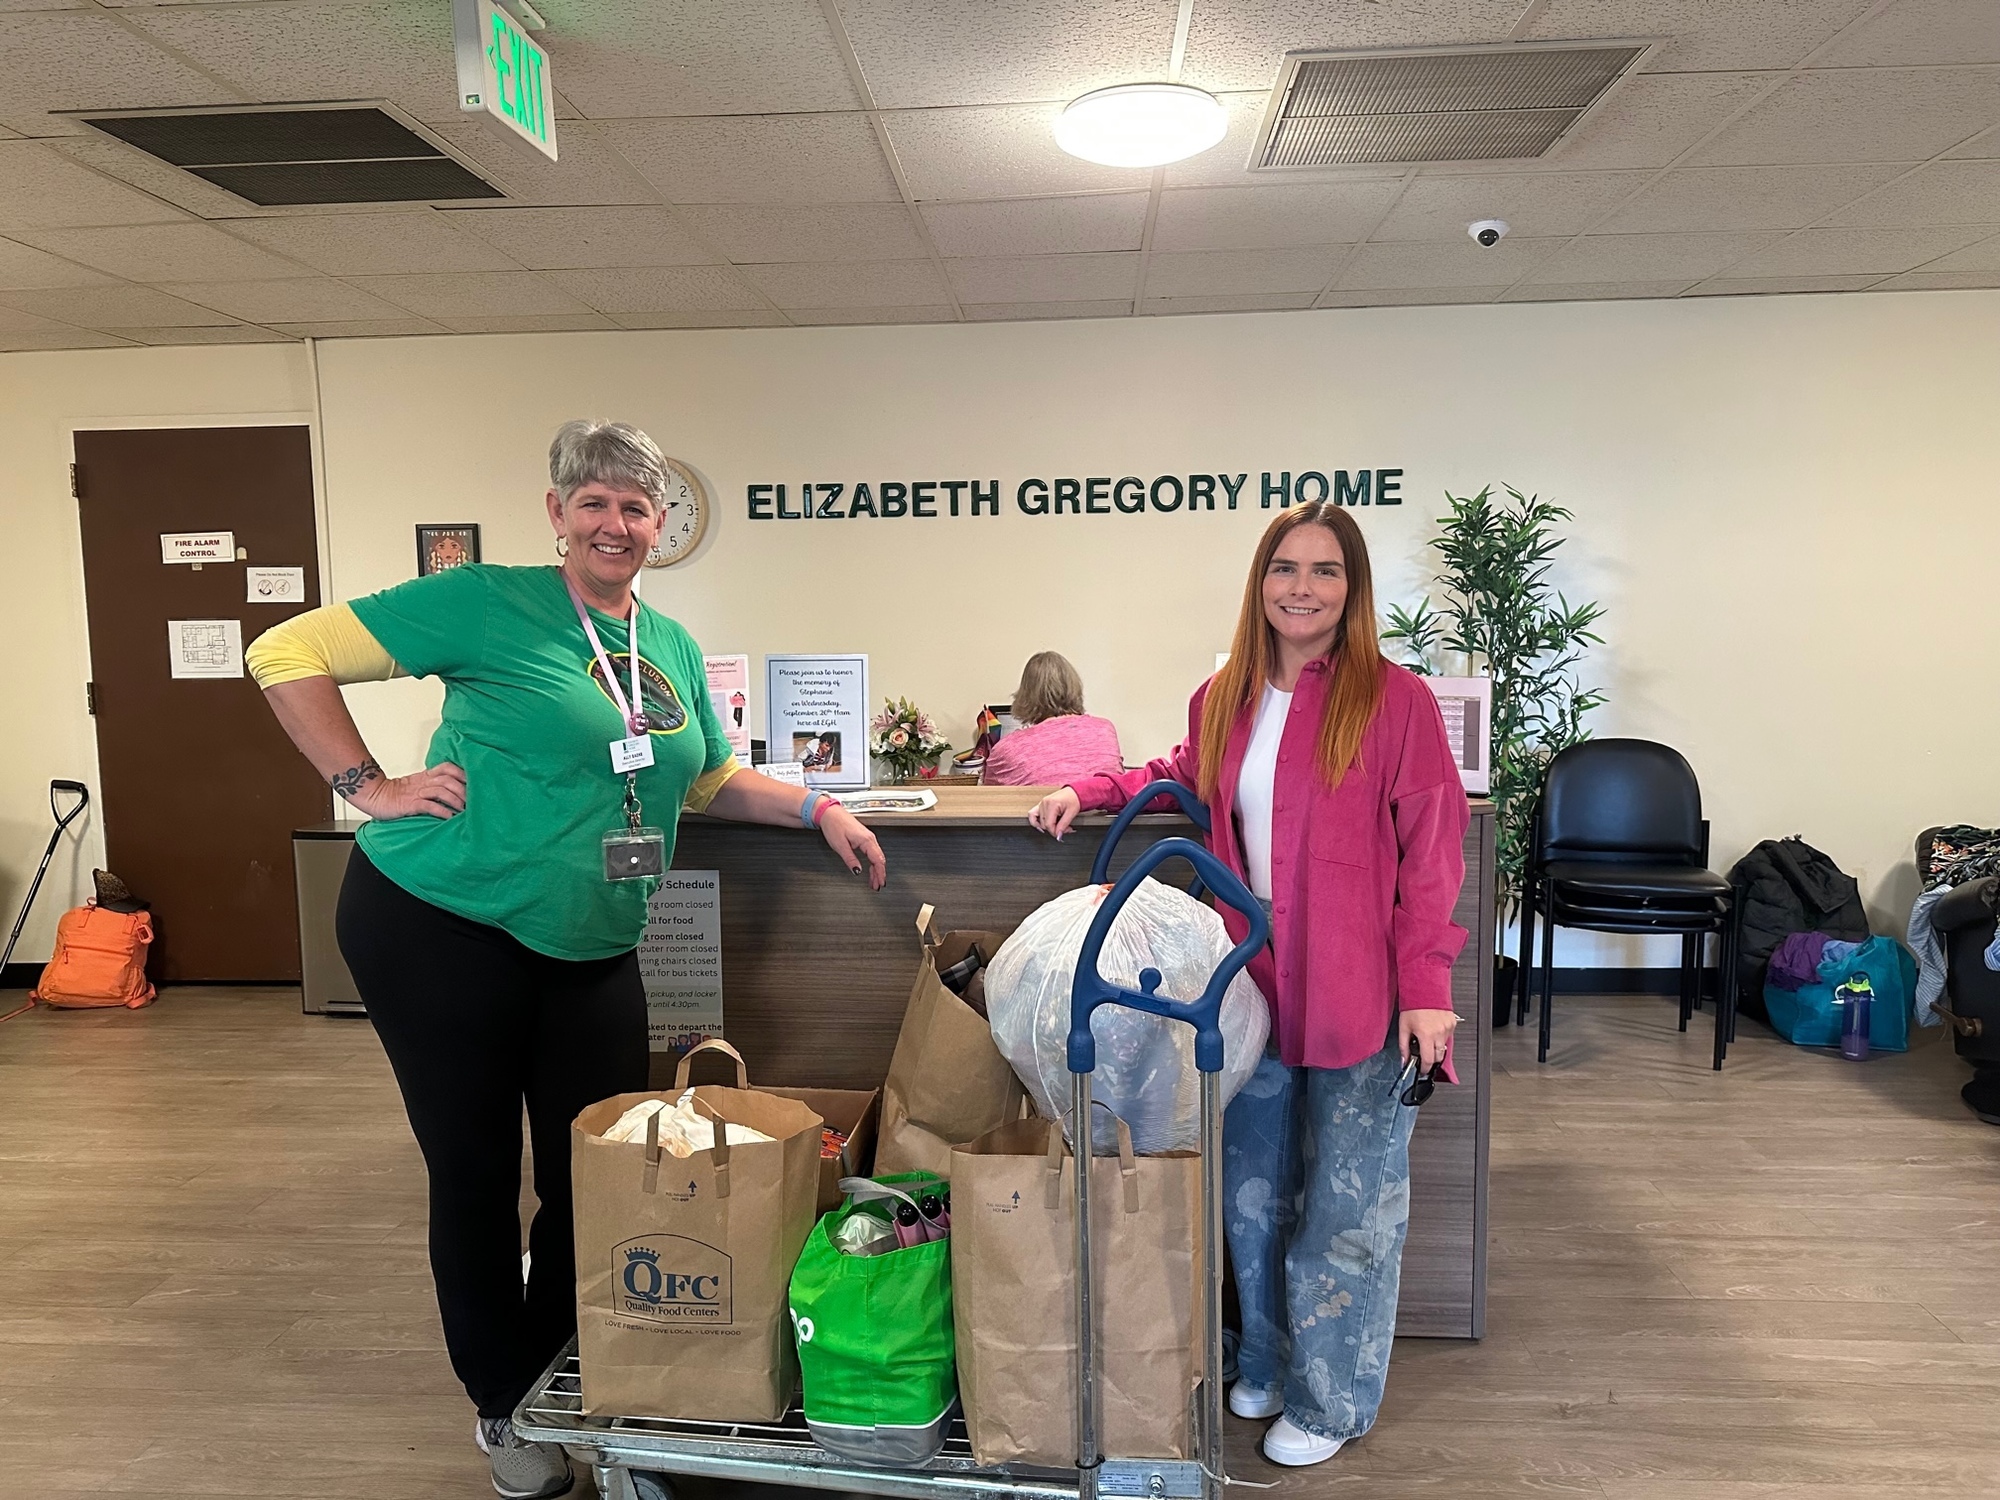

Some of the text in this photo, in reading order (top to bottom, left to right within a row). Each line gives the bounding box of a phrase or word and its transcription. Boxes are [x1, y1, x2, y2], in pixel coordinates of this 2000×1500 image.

[492, 12, 547, 144] EXIT
[679, 485, 688, 498] 2
[747, 468, 1404, 519] ELIZABETH GREGORY HOME
[686, 504, 694, 517] 3
[681, 522, 690, 534] 4
[174, 539, 221, 548] FIRE ALARM
[669, 535, 678, 548] 5
[179, 549, 217, 557] CONTROL
[800, 669, 815, 677] join
[625, 660, 673, 697] ICLUSION
[832, 679, 841, 687] of
[799, 688, 833, 696] Stephanie
[783, 709, 818, 717] September
[665, 879, 715, 890] Schedule
[685, 901, 714, 909] closed
[658, 916, 672, 924] for
[673, 916, 694, 925] food
[675, 932, 704, 941] closed
[690, 945, 719, 953] closed
[661, 957, 687, 965] chairs
[688, 957, 717, 965] closed
[640, 969, 718, 977] call for bus tickets
[678, 1023, 707, 1032] depart
[708, 1023, 722, 1031] the
[623, 1260, 719, 1305] QFC
[625, 1300, 720, 1317] Quality Food Centers
[604, 1320, 622, 1328] LOVE
[622, 1323, 644, 1331] FRESH
